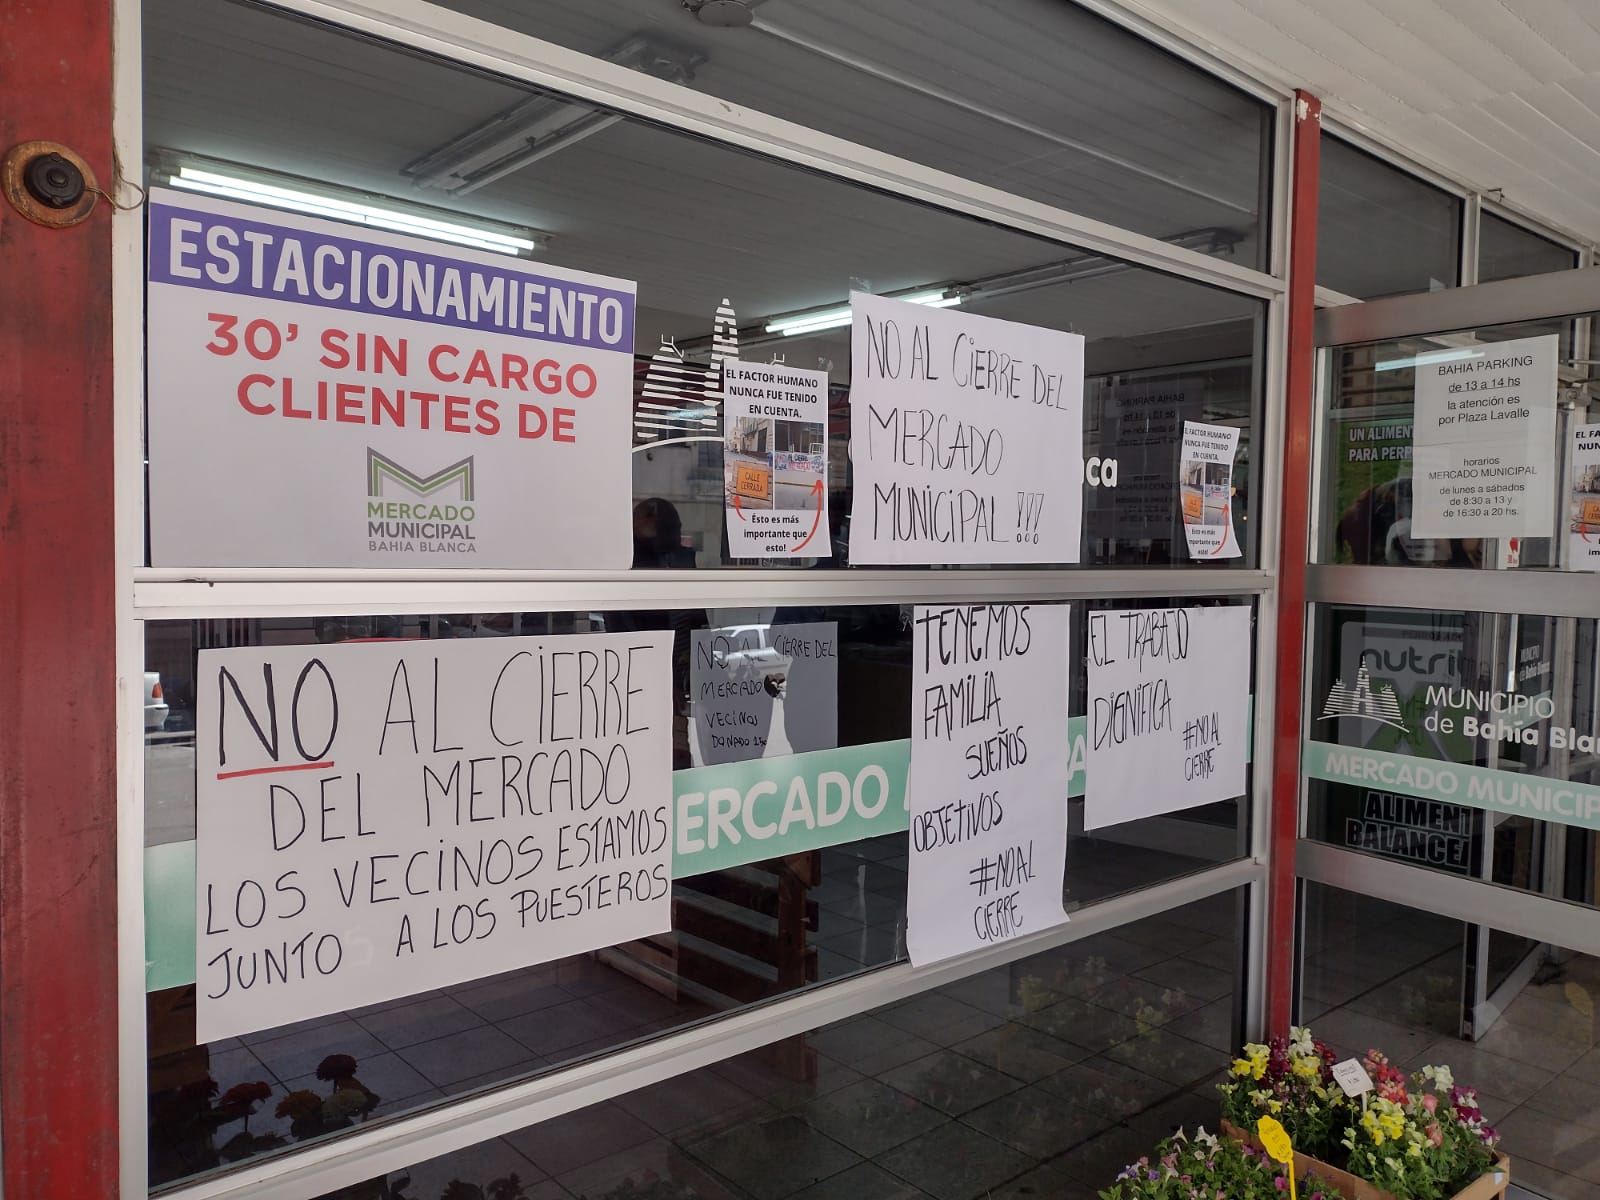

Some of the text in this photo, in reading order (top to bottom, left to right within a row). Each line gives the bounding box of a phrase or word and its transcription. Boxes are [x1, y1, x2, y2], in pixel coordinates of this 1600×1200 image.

[169, 217, 623, 345] ESTACIONAMIENTO
[319, 328, 407, 377] SIN
[427, 344, 598, 399] CARGO
[866, 314, 901, 380] NO
[910, 325, 939, 380] AL
[1032, 363, 1068, 411] DEL
[1438, 355, 1533, 376] BAHIA PARKING
[726, 369, 818, 388] EL FACTOR HUMANO
[1448, 376, 1521, 393] de 13 a 14 hs
[729, 386, 817, 403] NUNCA FUE TENIDO
[1447, 395, 1521, 410] la atención es
[236, 373, 576, 443] CLIENTES DE
[749, 404, 802, 418] EN CUENTA.
[1438, 408, 1530, 427] por Plaza Lavalle
[869, 403, 1003, 476] MERCADO
[1350, 428, 1365, 441] UN
[1349, 446, 1413, 462] PARA PERR
[1578, 443, 1600, 451] NUN
[1463, 457, 1500, 467] horarios
[1428, 466, 1537, 480] MERCADO MUNICIPAL
[1439, 487, 1450, 495] de
[1452, 486, 1476, 494] lunes
[1486, 483, 1525, 493] sábados
[1450, 495, 1513, 506] de 8:30 a 13 y
[366, 502, 476, 521] MERCADO
[771, 516, 781, 524] es
[782, 514, 799, 524] más
[1443, 509, 1454, 518] de
[1457, 508, 1481, 517] 16:30
[1491, 508, 1503, 516] 20
[367, 522, 476, 540] MUNICIPAL
[743, 529, 808, 540] importante que
[368, 541, 477, 553] BAHIA BLANCA
[765, 544, 786, 553] esto!
[916, 604, 1031, 673] TENEMOS
[1091, 608, 1189, 672] EL TRABAJO
[698, 635, 730, 670] NO
[815, 639, 836, 658] DEL
[701, 680, 763, 700] MERCADO
[218, 658, 338, 766] NO
[379, 657, 463, 755] AL
[1425, 685, 1555, 719] MUNICIPIO
[1424, 711, 1600, 753] de Bahía Bla
[965, 725, 1027, 779] SUEÑOS
[1185, 748, 1215, 781] CIERRE
[1325, 751, 1600, 821] MERCADO MUNICIP
[270, 743, 630, 852] DEL MERCADO
[676, 764, 890, 856] ERCADO
[1364, 790, 1472, 837] ALIMENT
[206, 871, 306, 935] LOS
[557, 806, 667, 872] ESTAMOS
[974, 890, 1023, 942] CIERRE
[207, 863, 668, 1000] JUNTO A LOS PUESTEROS
